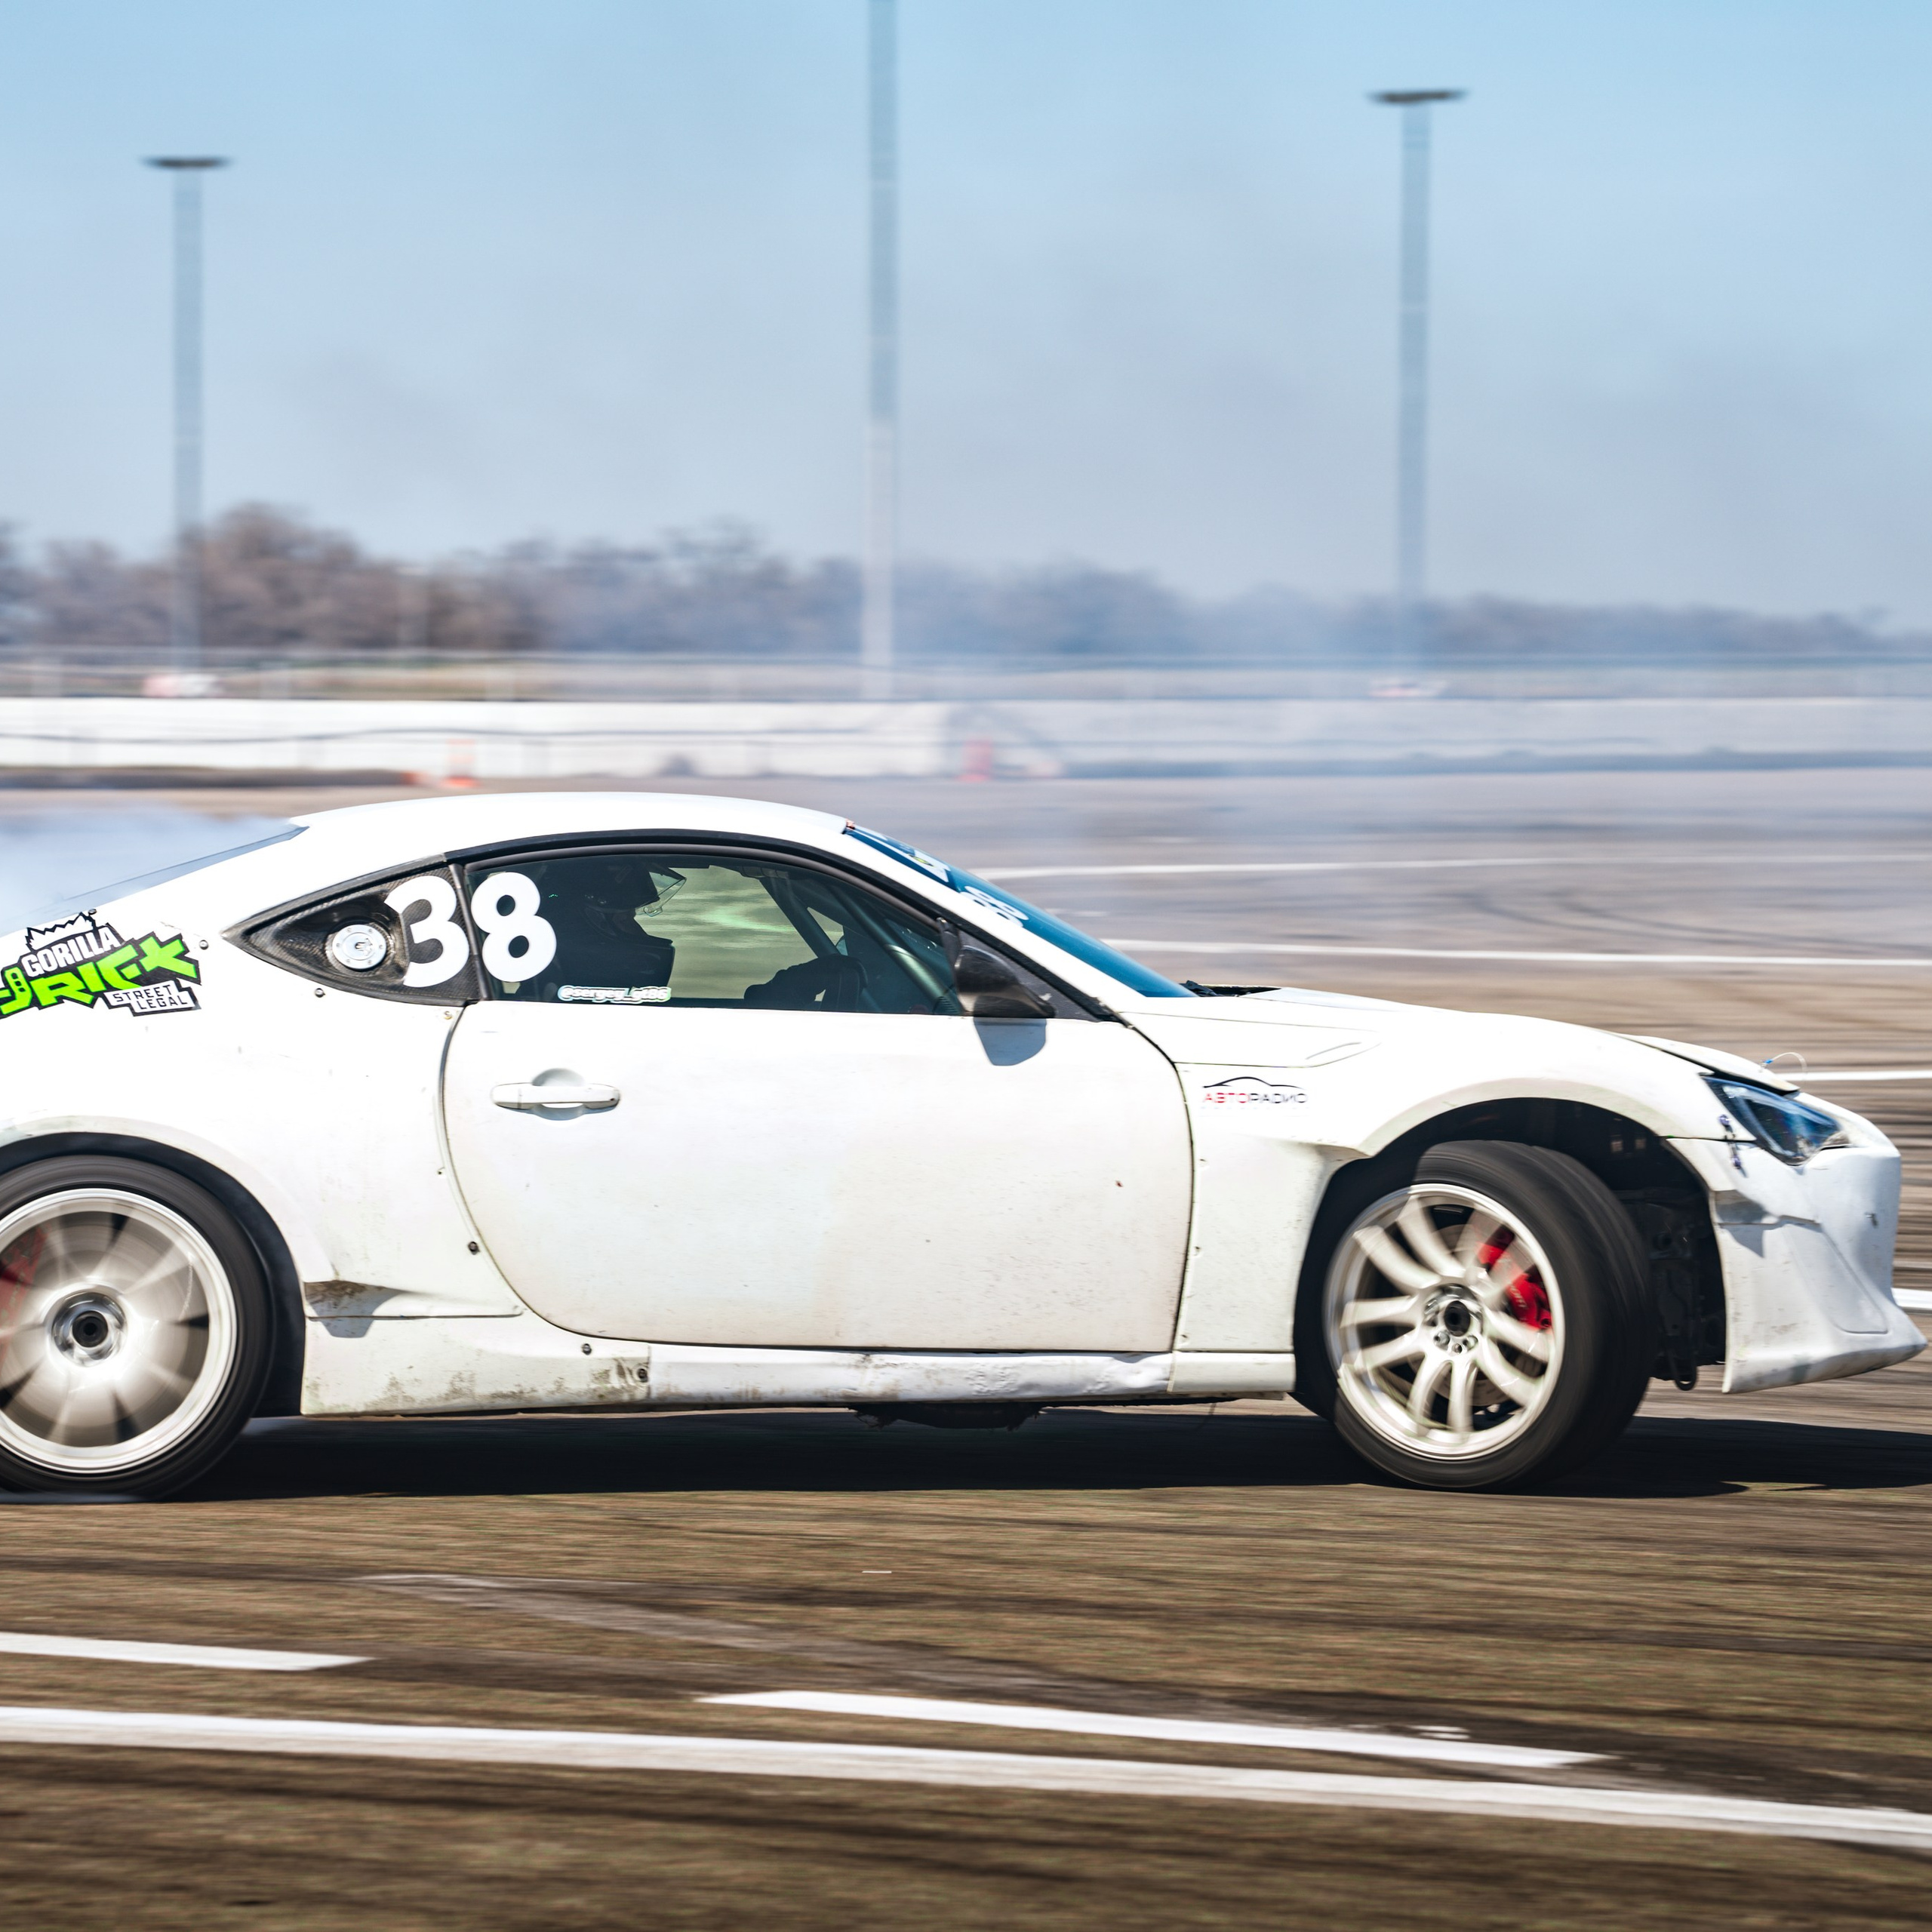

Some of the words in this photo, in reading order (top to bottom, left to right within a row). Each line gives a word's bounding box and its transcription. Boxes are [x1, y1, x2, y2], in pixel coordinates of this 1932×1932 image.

[384, 872, 557, 987] 38
[21, 929, 122, 977] GORILLA
[112, 984, 173, 1002] STREET
[139, 997, 188, 1010] LEGAL
